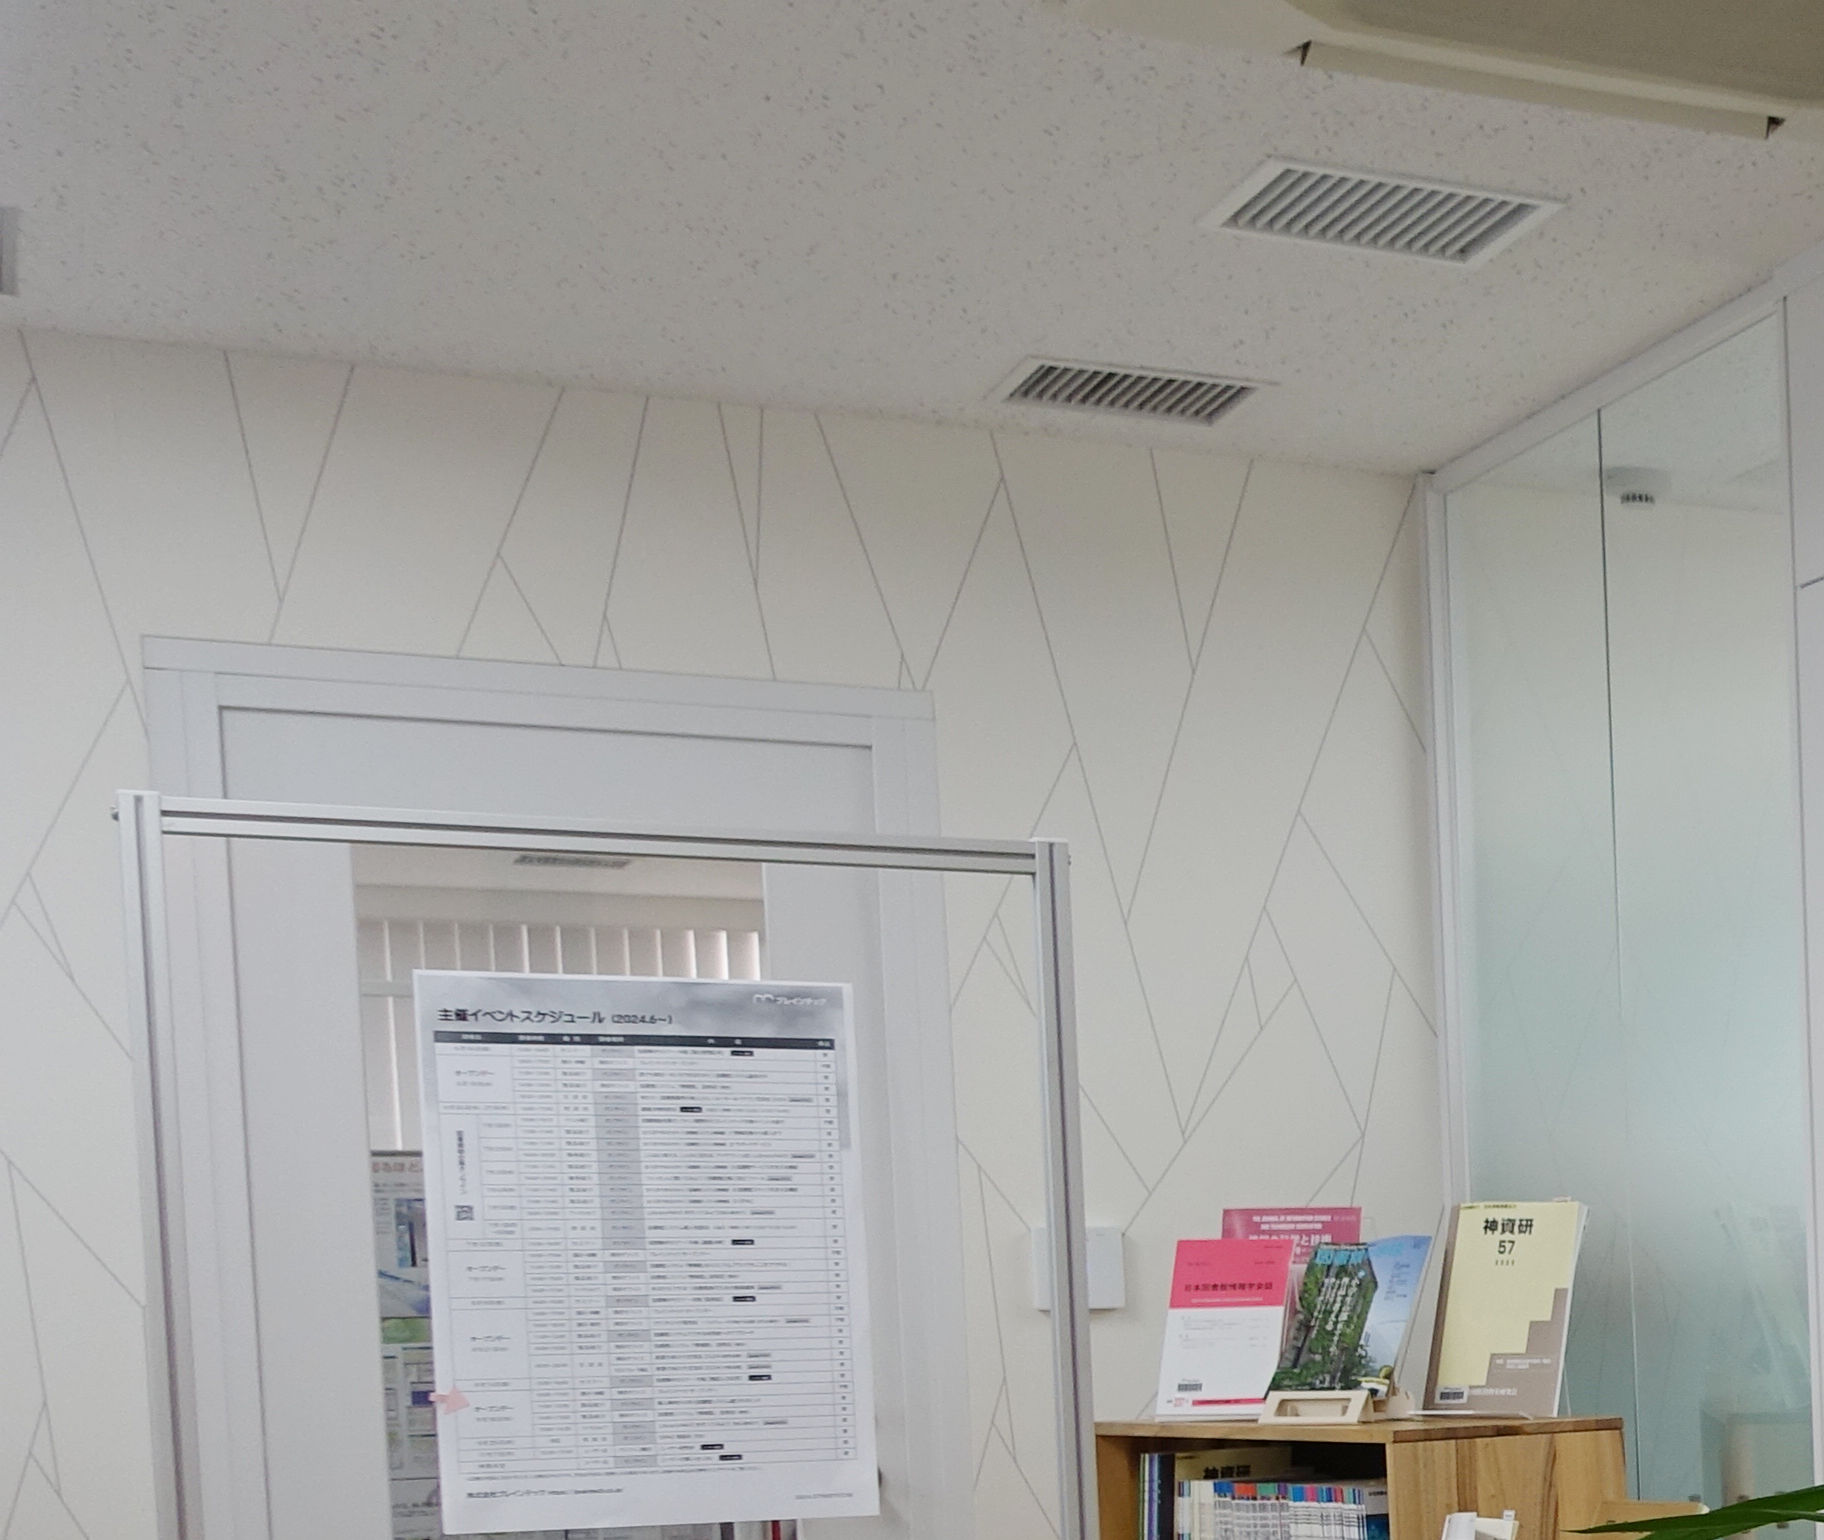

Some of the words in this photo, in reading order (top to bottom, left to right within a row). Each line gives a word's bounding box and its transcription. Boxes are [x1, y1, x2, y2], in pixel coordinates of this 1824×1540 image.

[437, 1007, 605, 1026] 主催イベントスケジュール
[1482, 1217, 1535, 1236] 神資研
[1497, 1240, 1516, 1255] 57
